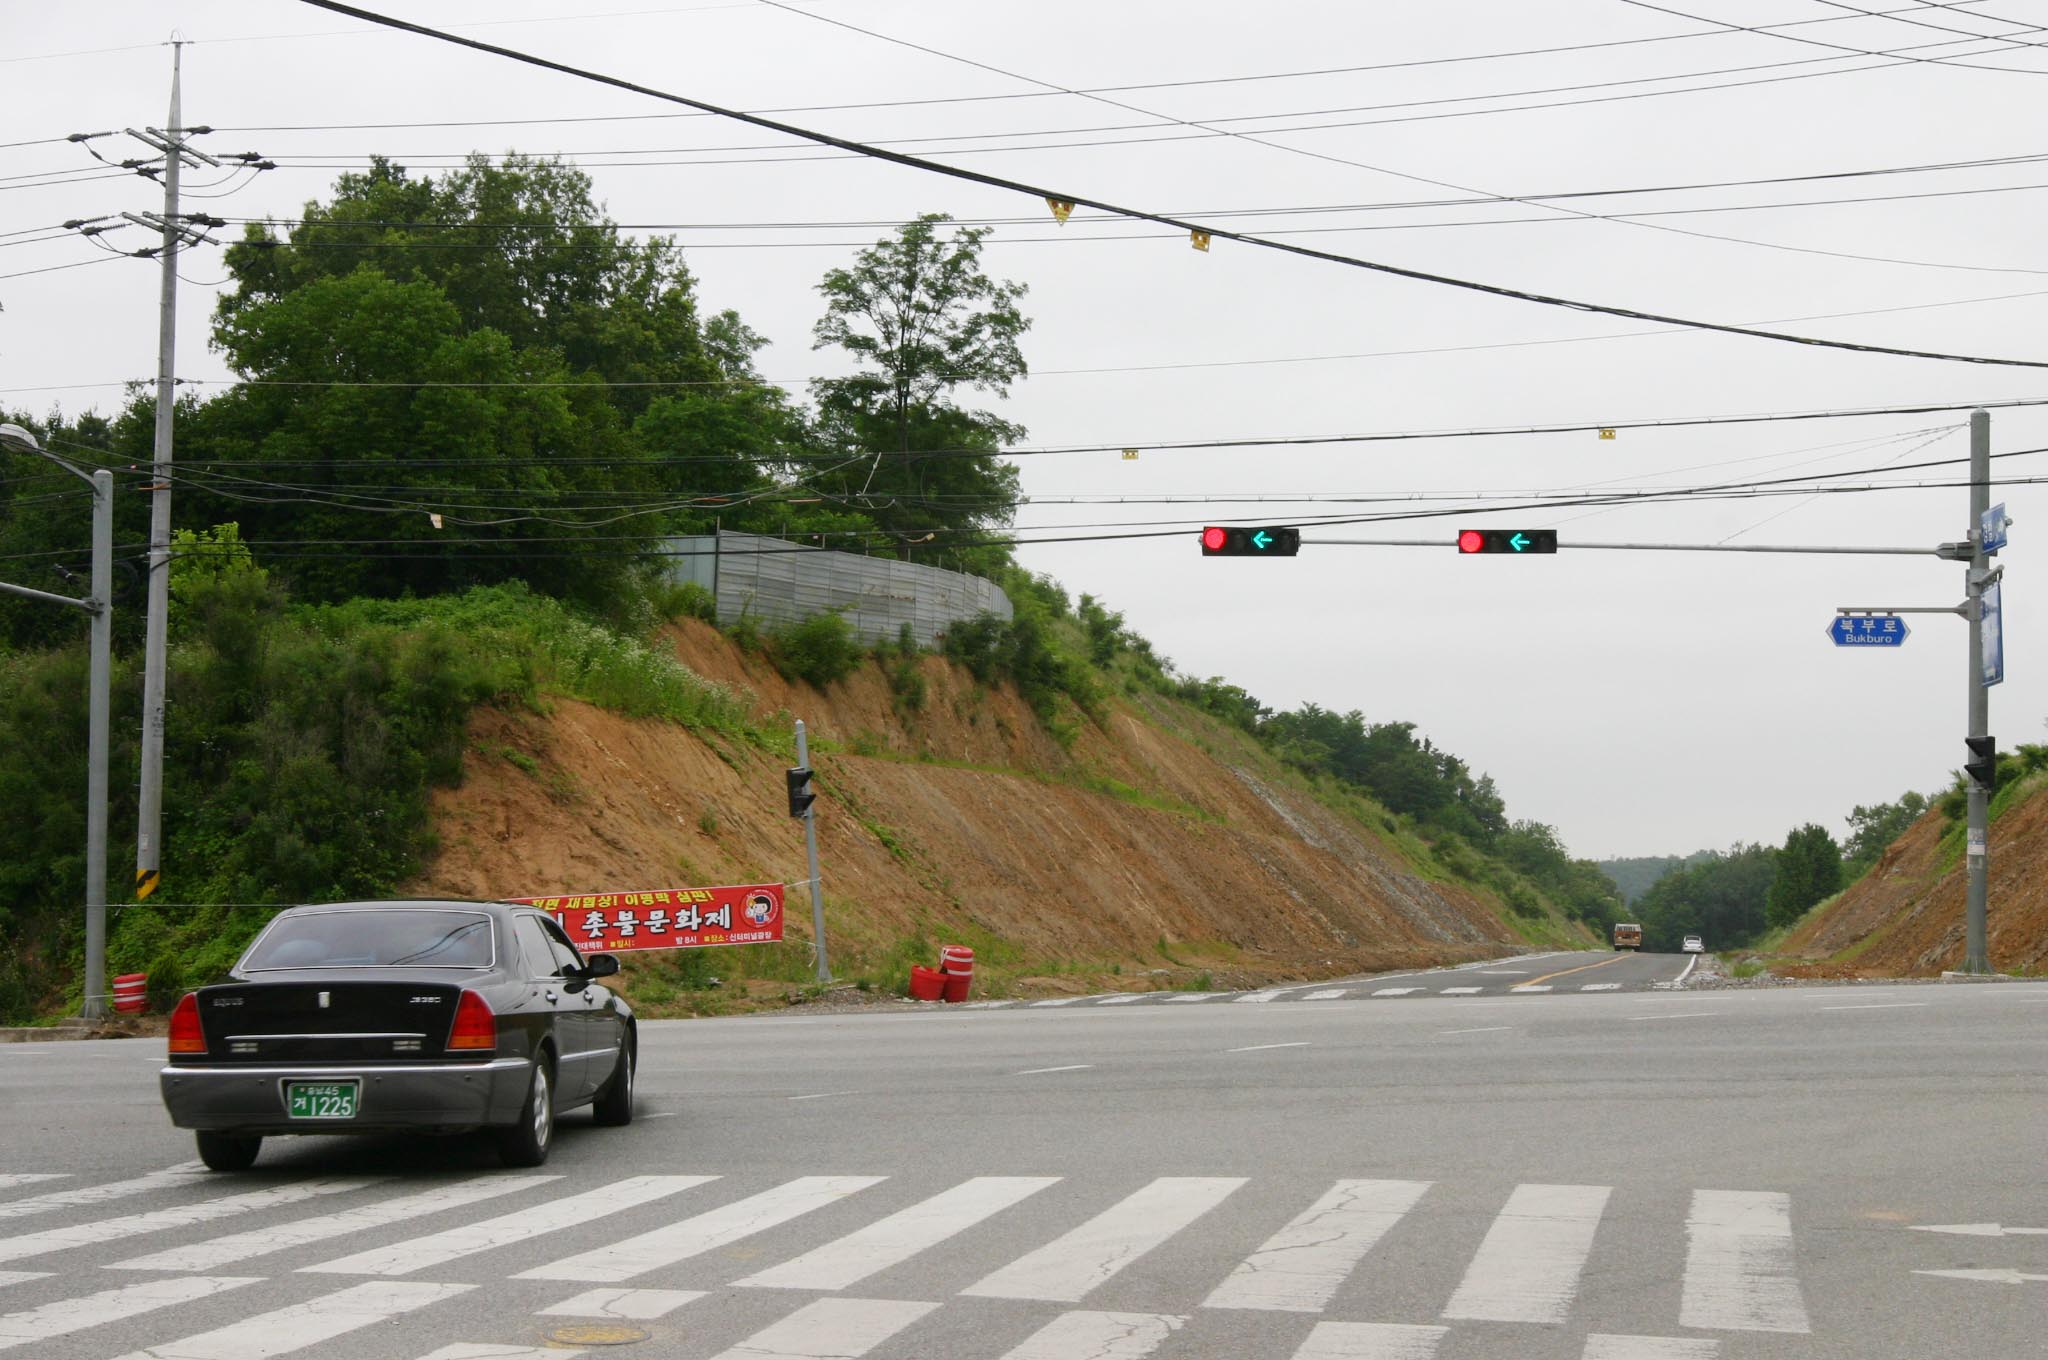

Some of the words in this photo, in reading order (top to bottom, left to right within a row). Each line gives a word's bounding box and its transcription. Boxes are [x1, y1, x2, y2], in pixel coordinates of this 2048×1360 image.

[1840, 619, 1898, 633] 북부로
[1845, 634, 1893, 643] Bukburo
[565, 895, 618, 909] 재협상!
[625, 892, 671, 906] 이명박
[677, 890, 715, 904] 심판!
[581, 903, 731, 939] 촛불문화제
[311, 1096, 352, 1116] 1225
